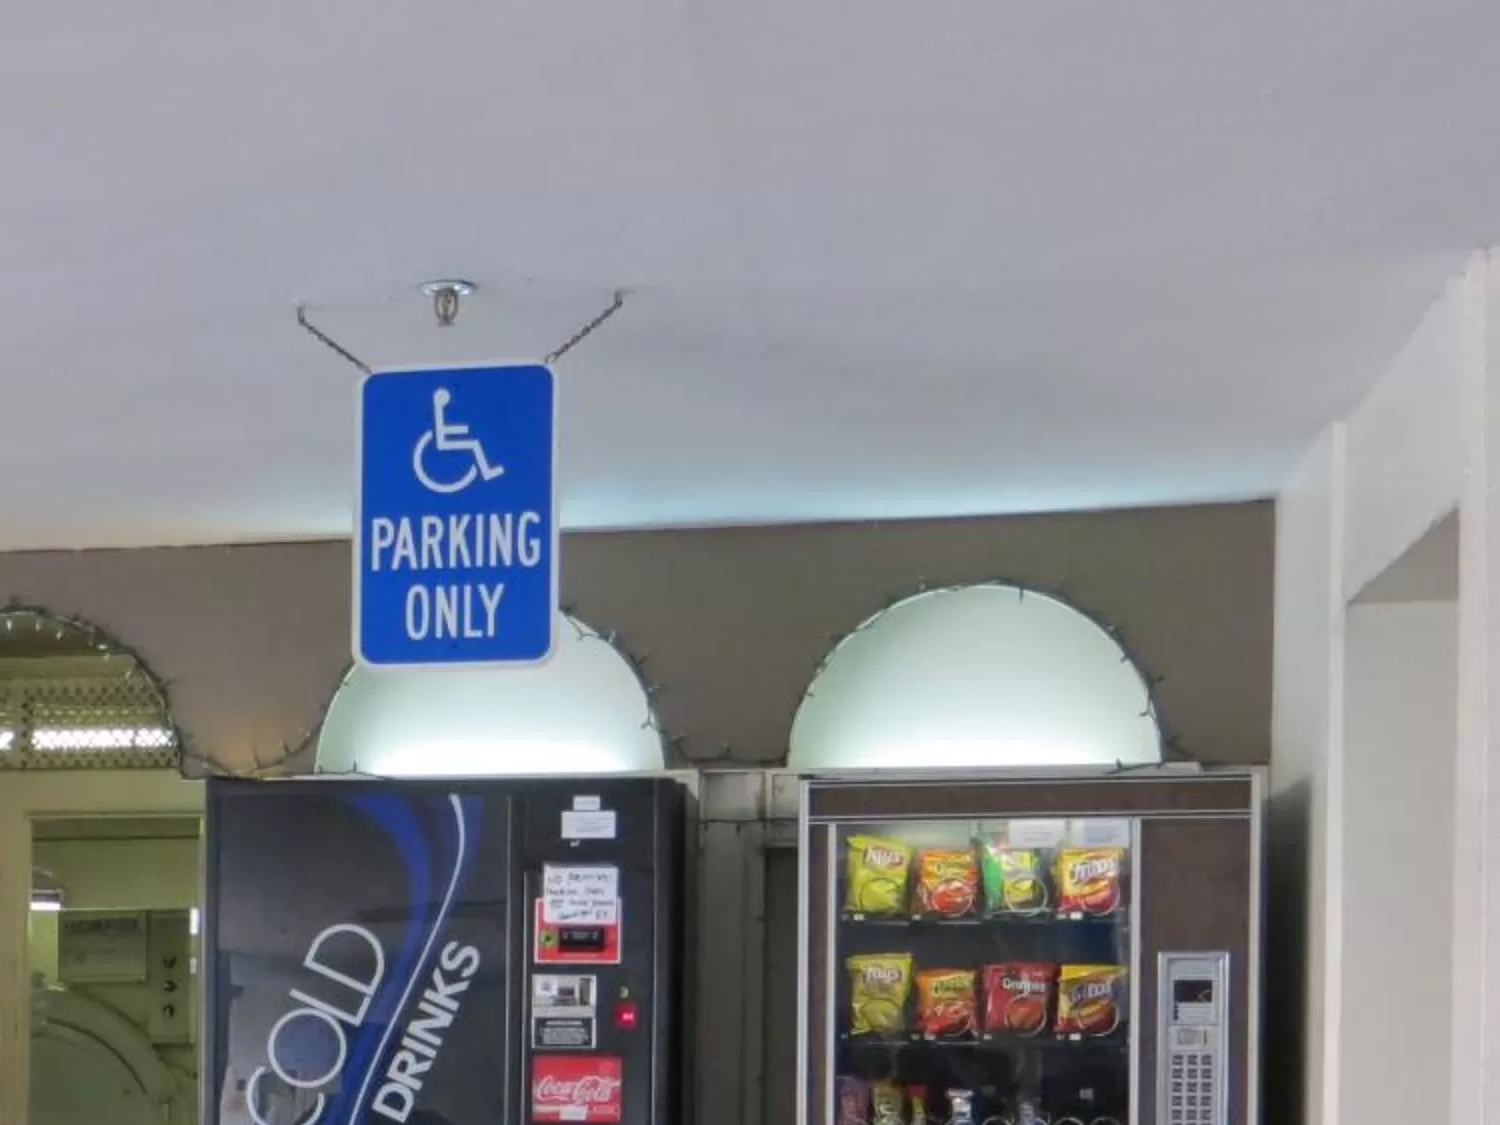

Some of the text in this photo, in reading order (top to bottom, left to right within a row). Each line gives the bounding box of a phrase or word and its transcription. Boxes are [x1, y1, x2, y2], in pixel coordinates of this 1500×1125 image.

[370, 511, 541, 572] PARKING
[404, 583, 505, 641] ONLY
[372, 940, 481, 1123] DRINKS
